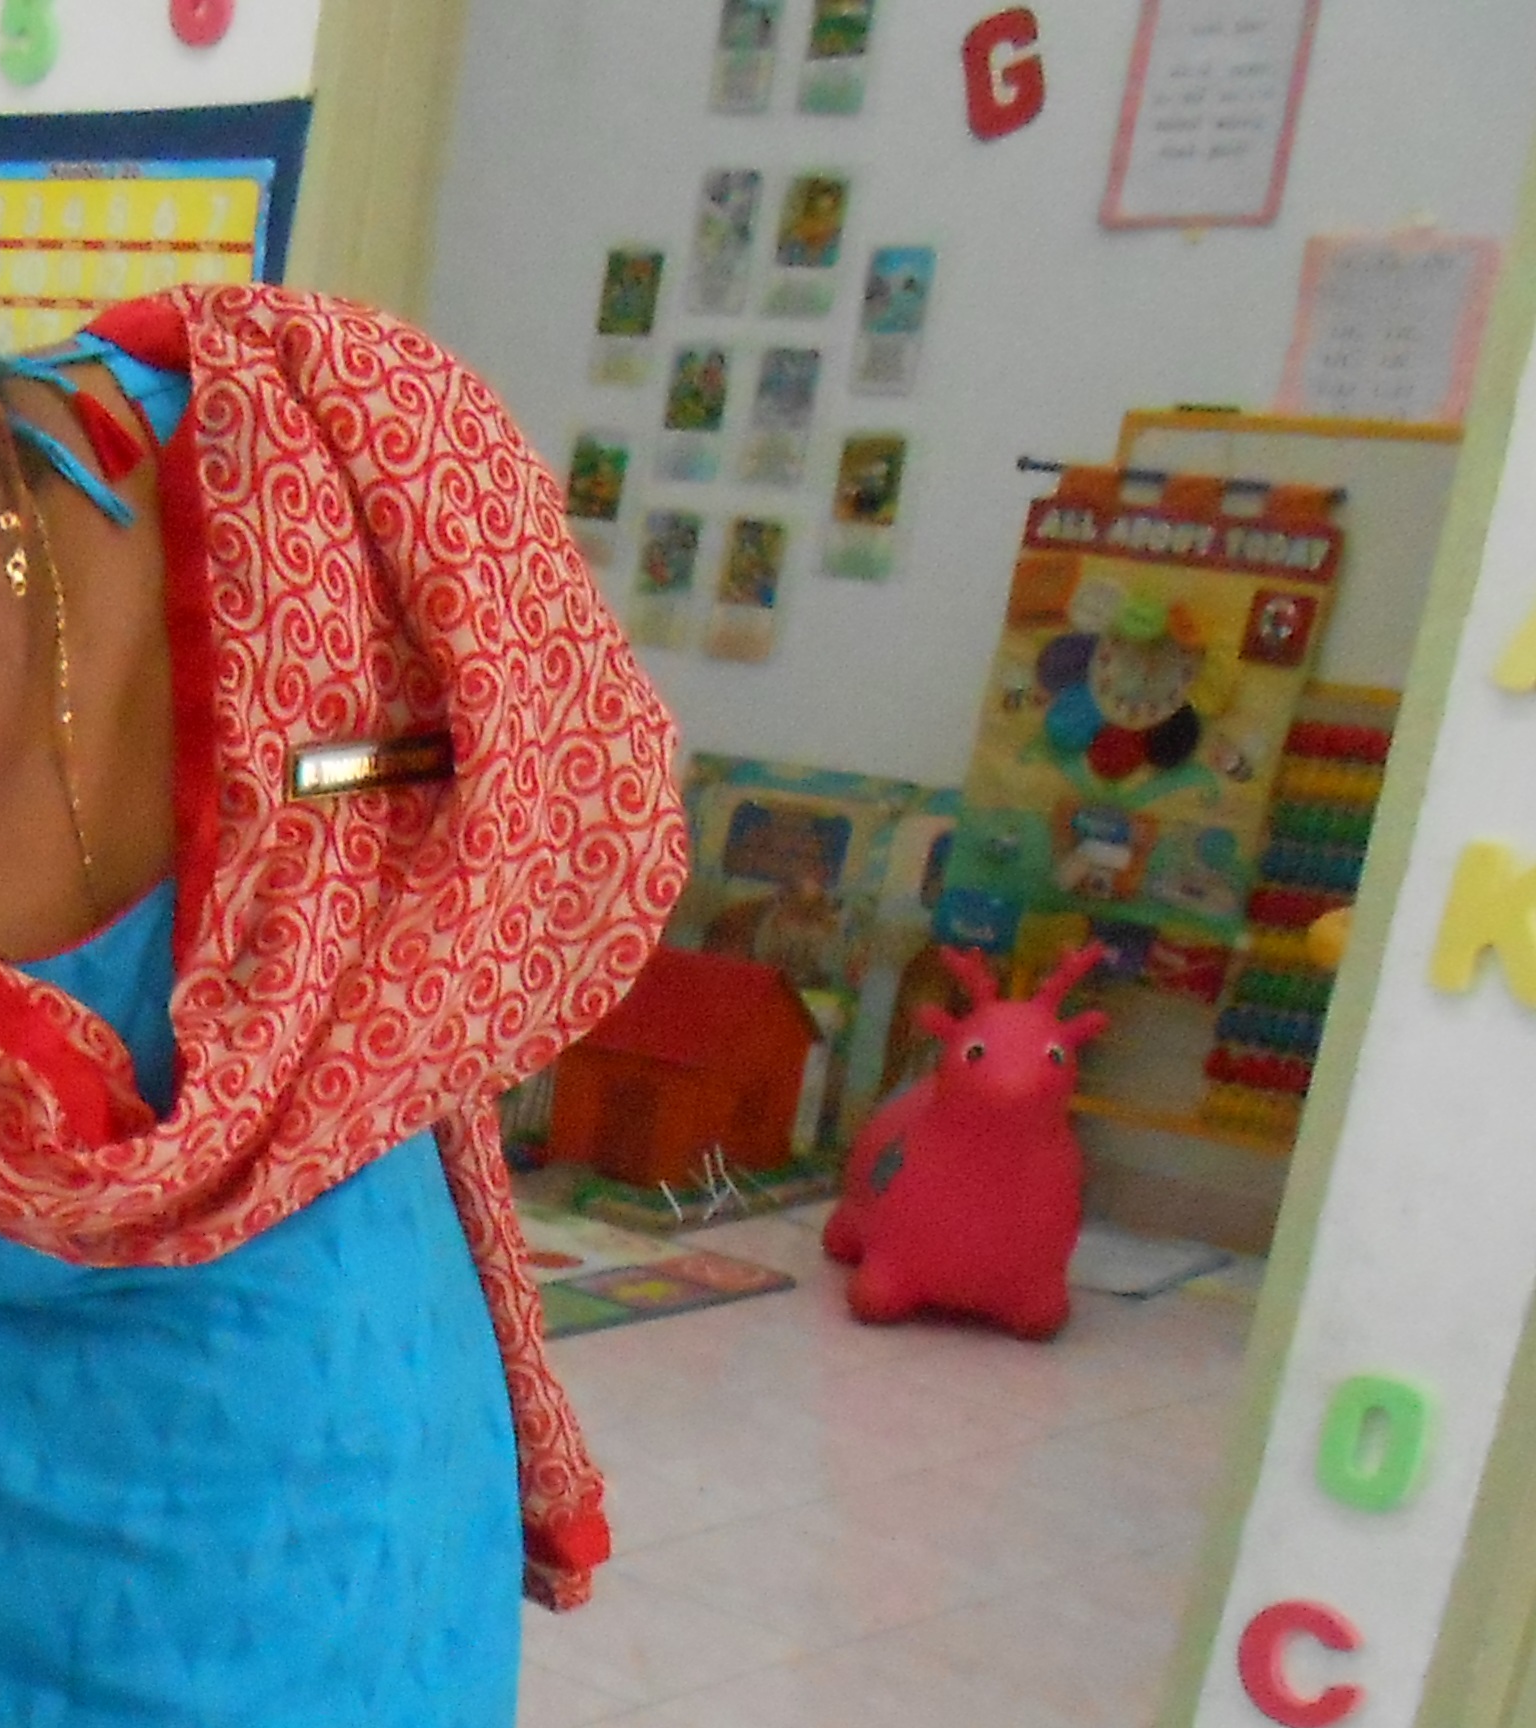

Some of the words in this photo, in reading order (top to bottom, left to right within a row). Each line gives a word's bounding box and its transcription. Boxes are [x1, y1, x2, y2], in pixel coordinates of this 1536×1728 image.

[962, 7, 1047, 141] G
[1037, 507, 1098, 540] ALL
[1106, 515, 1217, 556] ABOUT
[1227, 525, 1332, 571] TODAY
